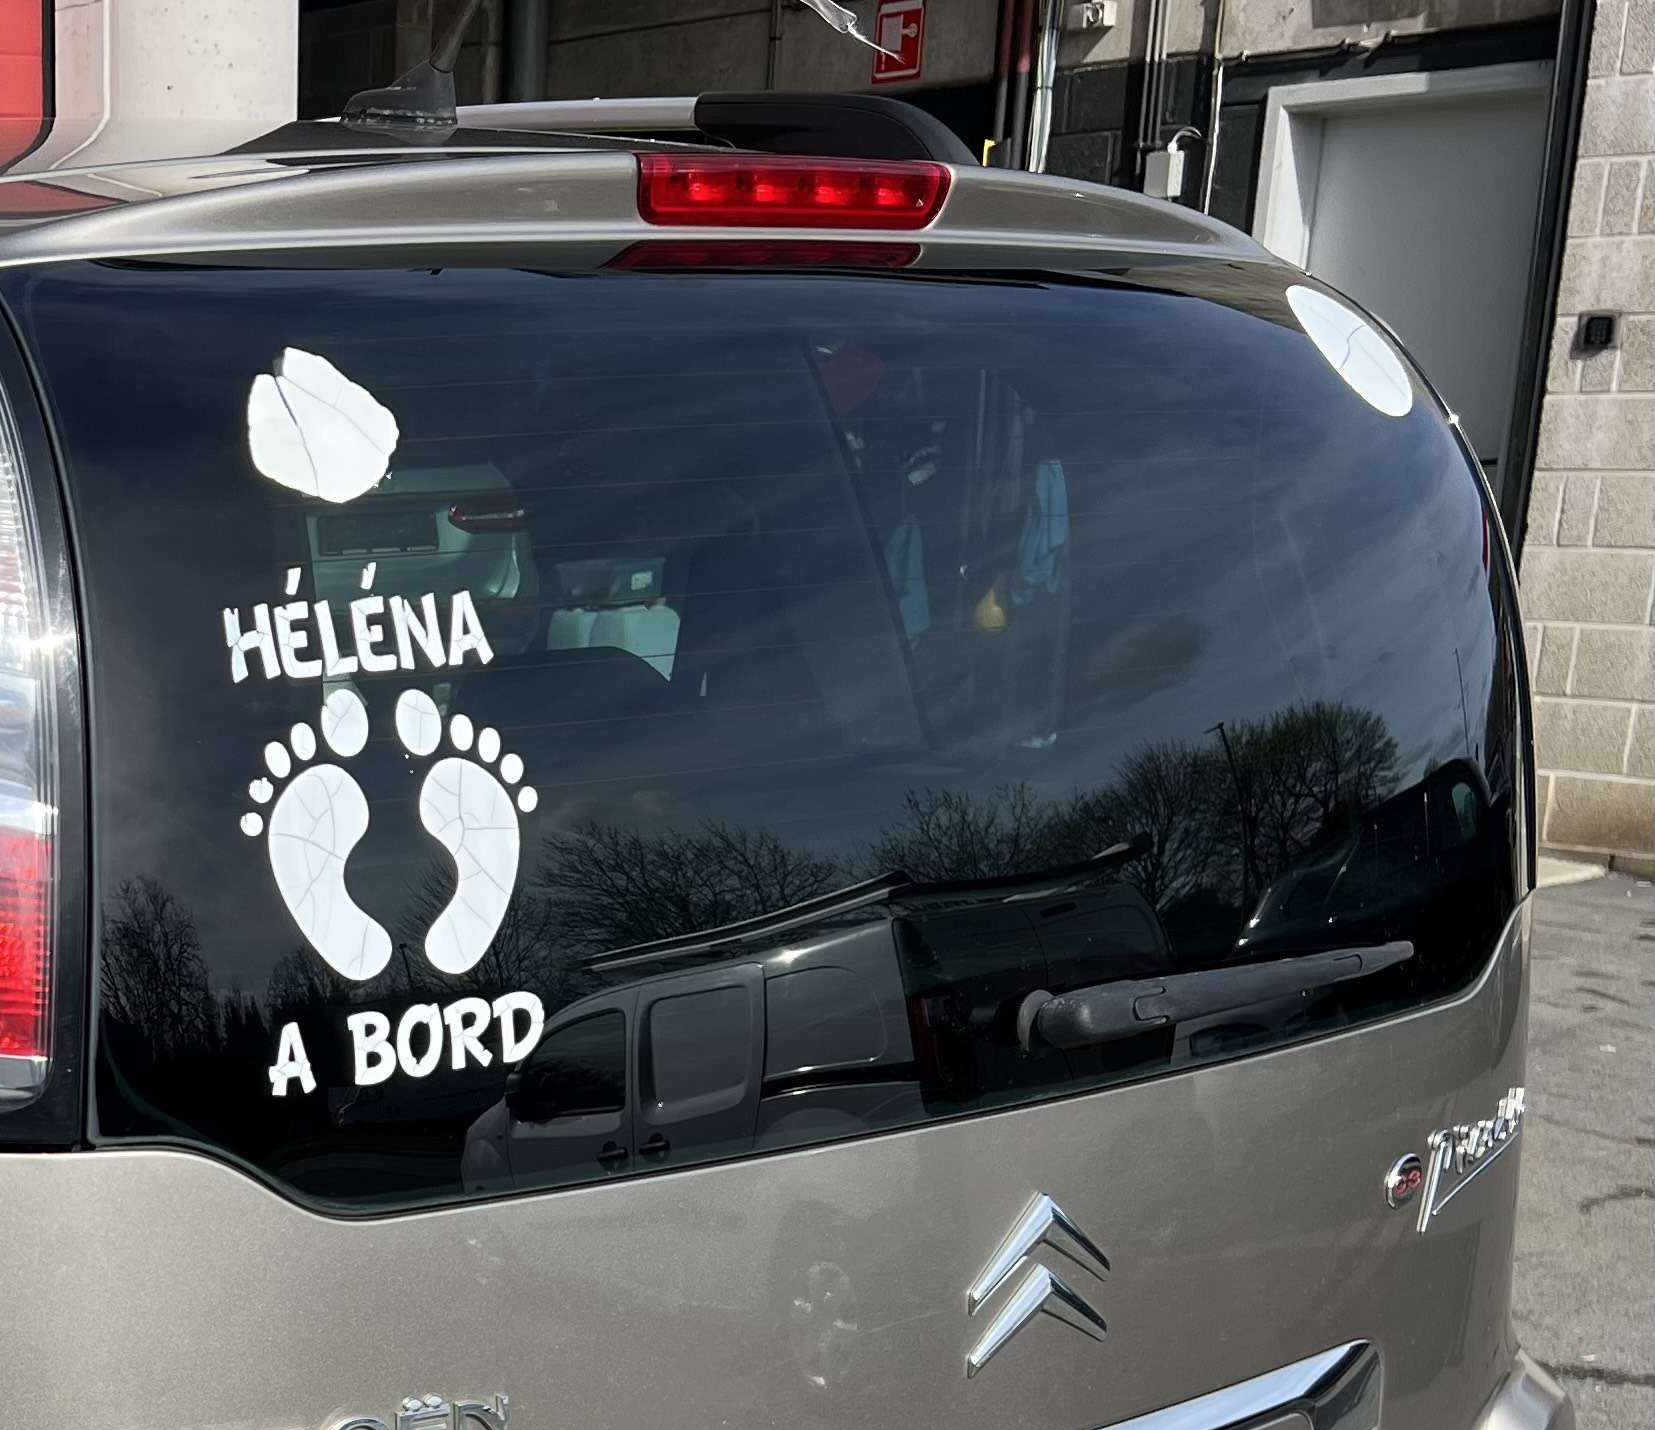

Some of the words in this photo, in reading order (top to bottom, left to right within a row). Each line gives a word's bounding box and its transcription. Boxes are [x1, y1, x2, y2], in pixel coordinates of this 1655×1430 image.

[223, 561, 495, 683] HÉLÉNA
[268, 1021, 317, 1096] A
[346, 990, 545, 1087] BORD
